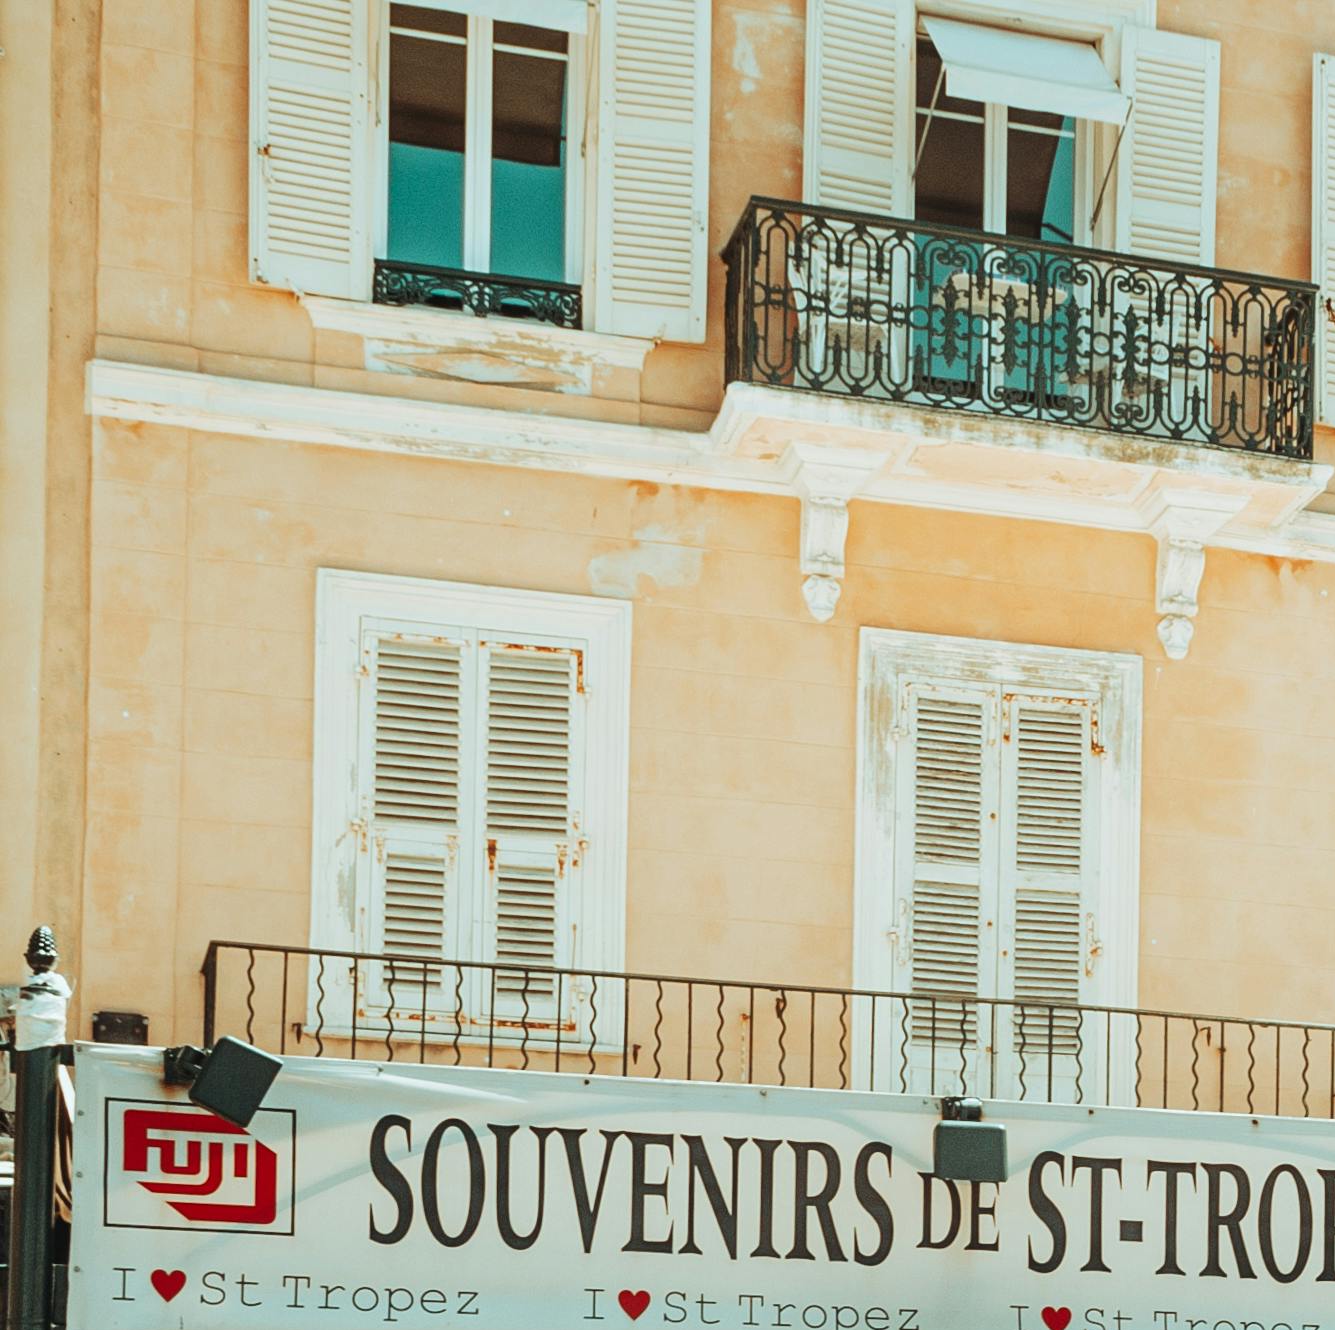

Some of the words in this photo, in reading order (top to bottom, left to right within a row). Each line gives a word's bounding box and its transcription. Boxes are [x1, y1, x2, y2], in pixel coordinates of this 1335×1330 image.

[127, 1116, 272, 1219] FUJI
[370, 1115, 893, 1266] SOUVENIRS
[917, 1173, 1000, 1251] DE
[112, 1267, 137, 1302] I
[200, 1271, 263, 1307] St
[283, 1275, 480, 1322] Tropez
[583, 1288, 606, 1320] I
[664, 1291, 722, 1325] St
